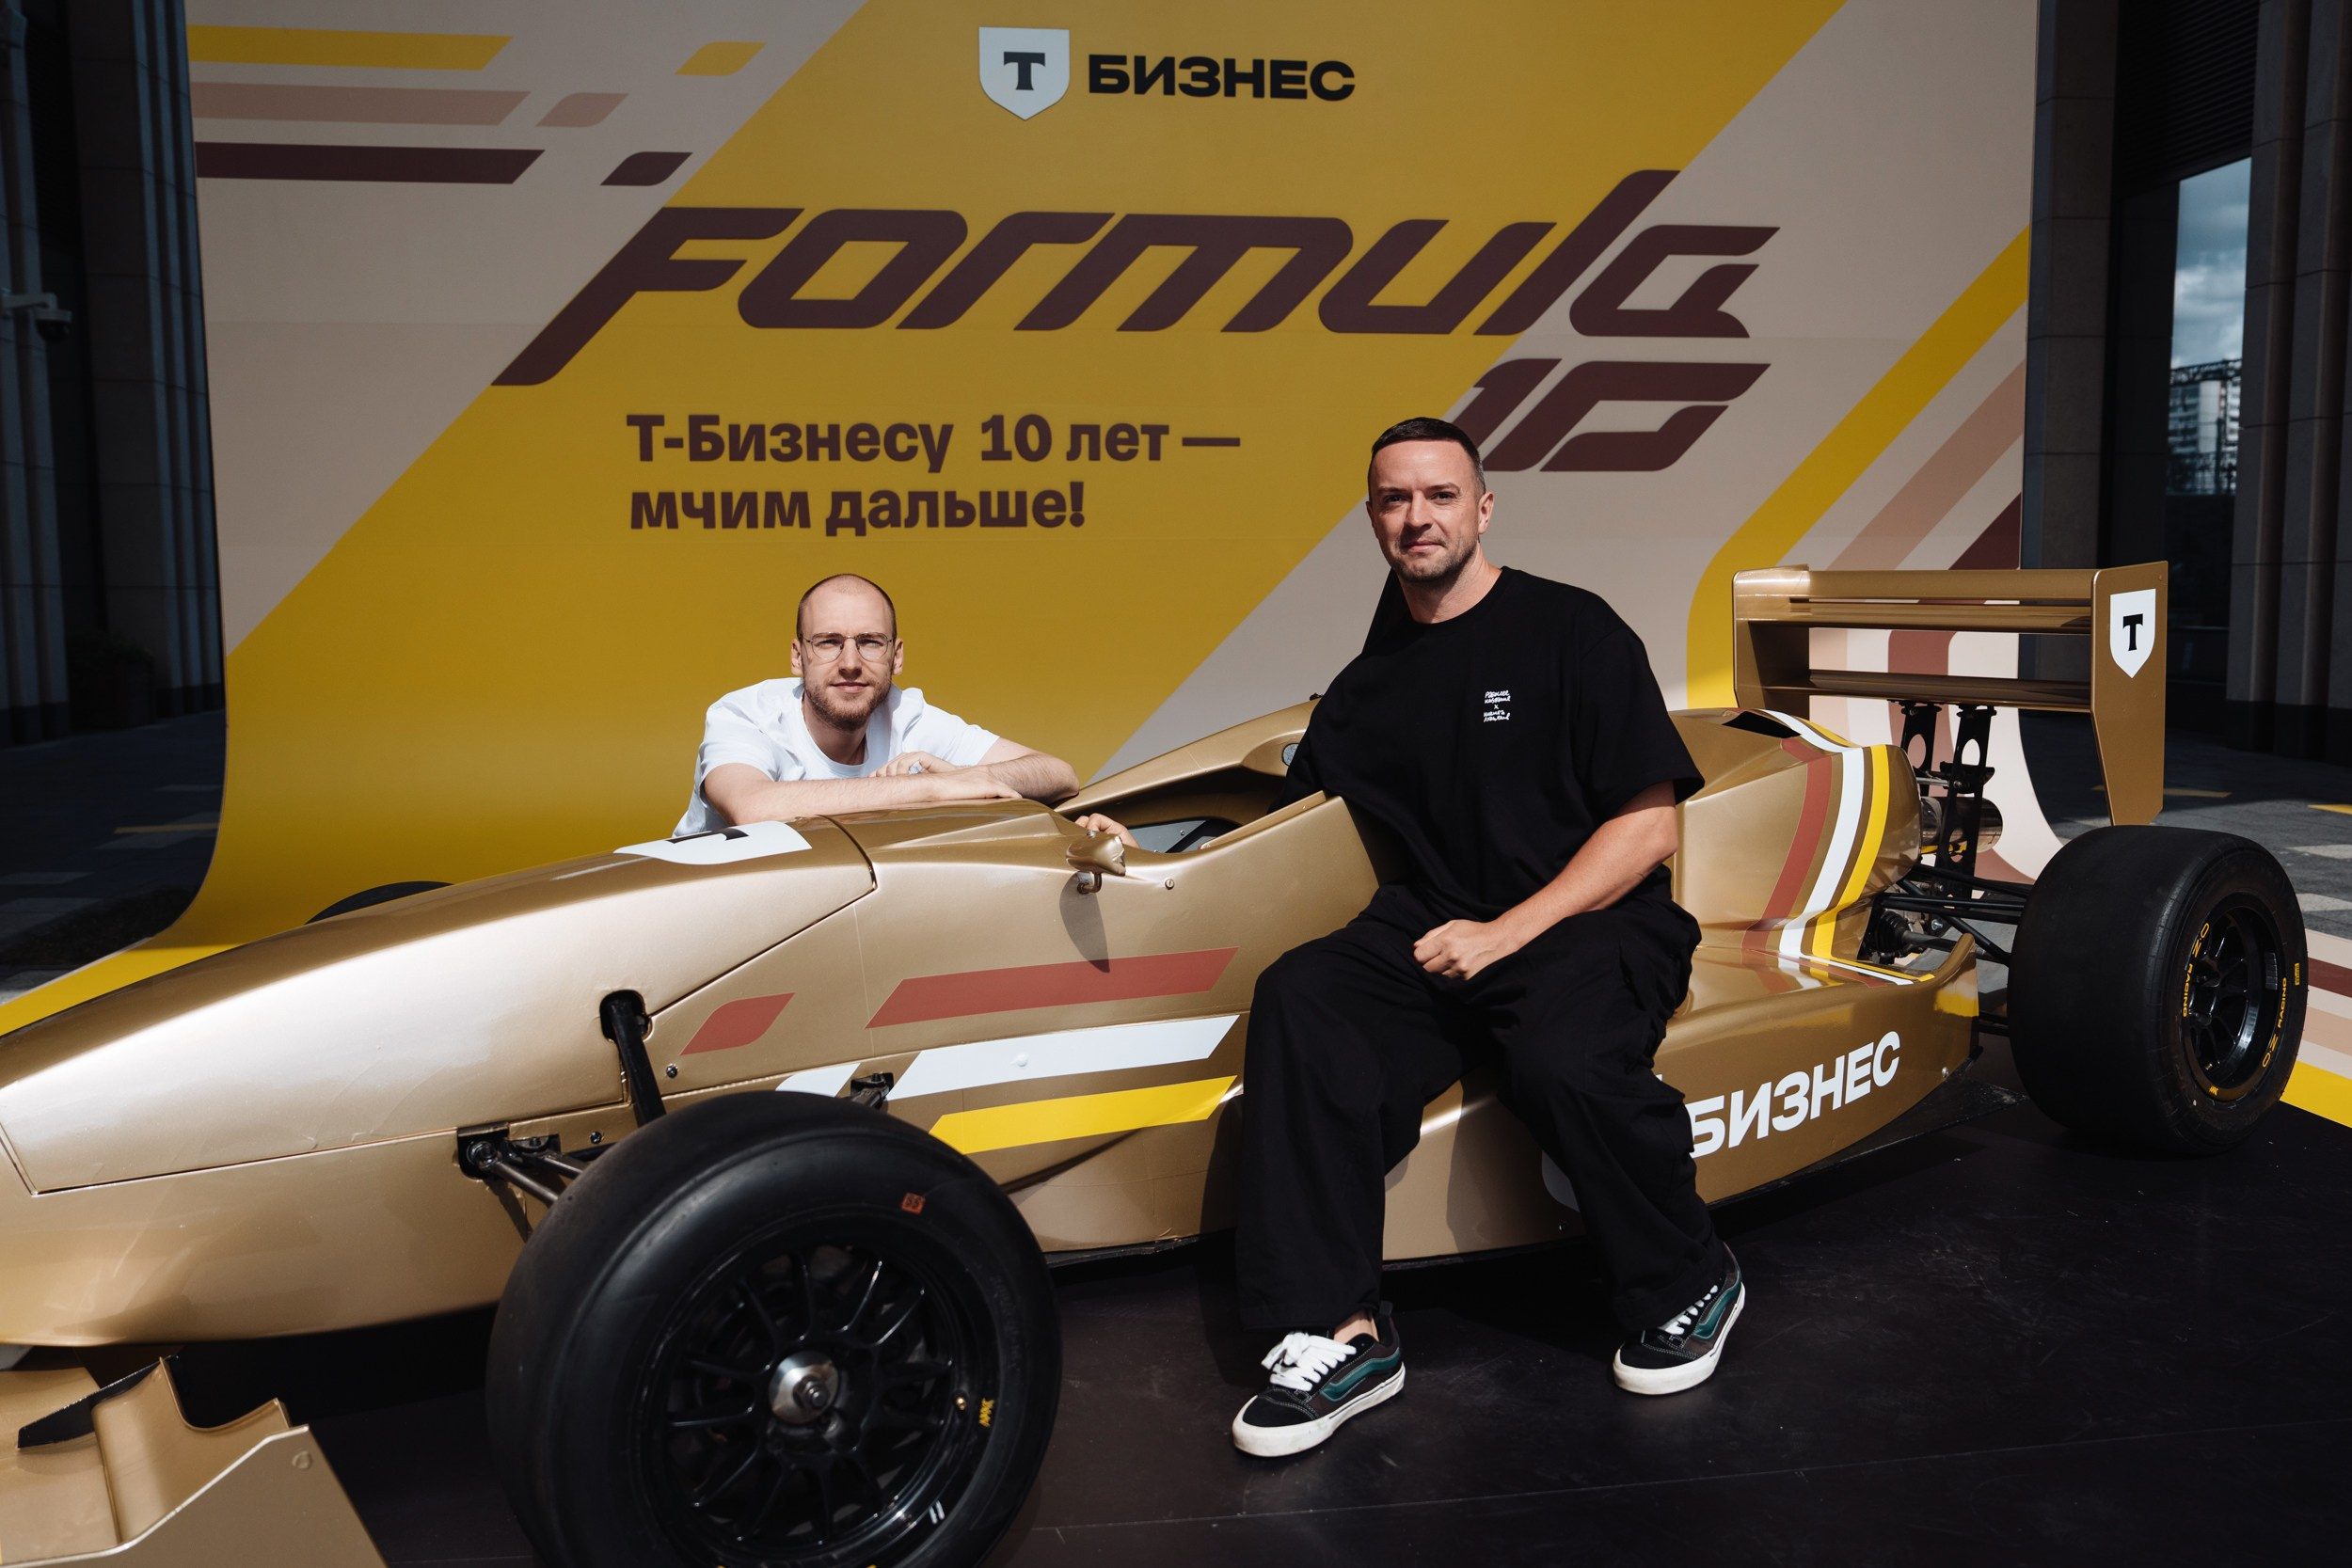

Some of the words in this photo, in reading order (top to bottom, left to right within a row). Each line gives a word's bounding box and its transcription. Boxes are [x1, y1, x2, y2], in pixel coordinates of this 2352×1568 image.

[1089, 55, 1356, 102] БИЗНЕС
[627, 414, 954, 474] Т-Бизнесу
[981, 414, 1053, 462] 10
[1066, 423, 1169, 462] лет
[630, 491, 811, 530] мчим
[826, 481, 1085, 537] дальше!
[2183, 963, 2194, 1018] RACING
[2277, 977, 2287, 1028] RACING
[1685, 1030, 1900, 1159] БИЗНЕС
